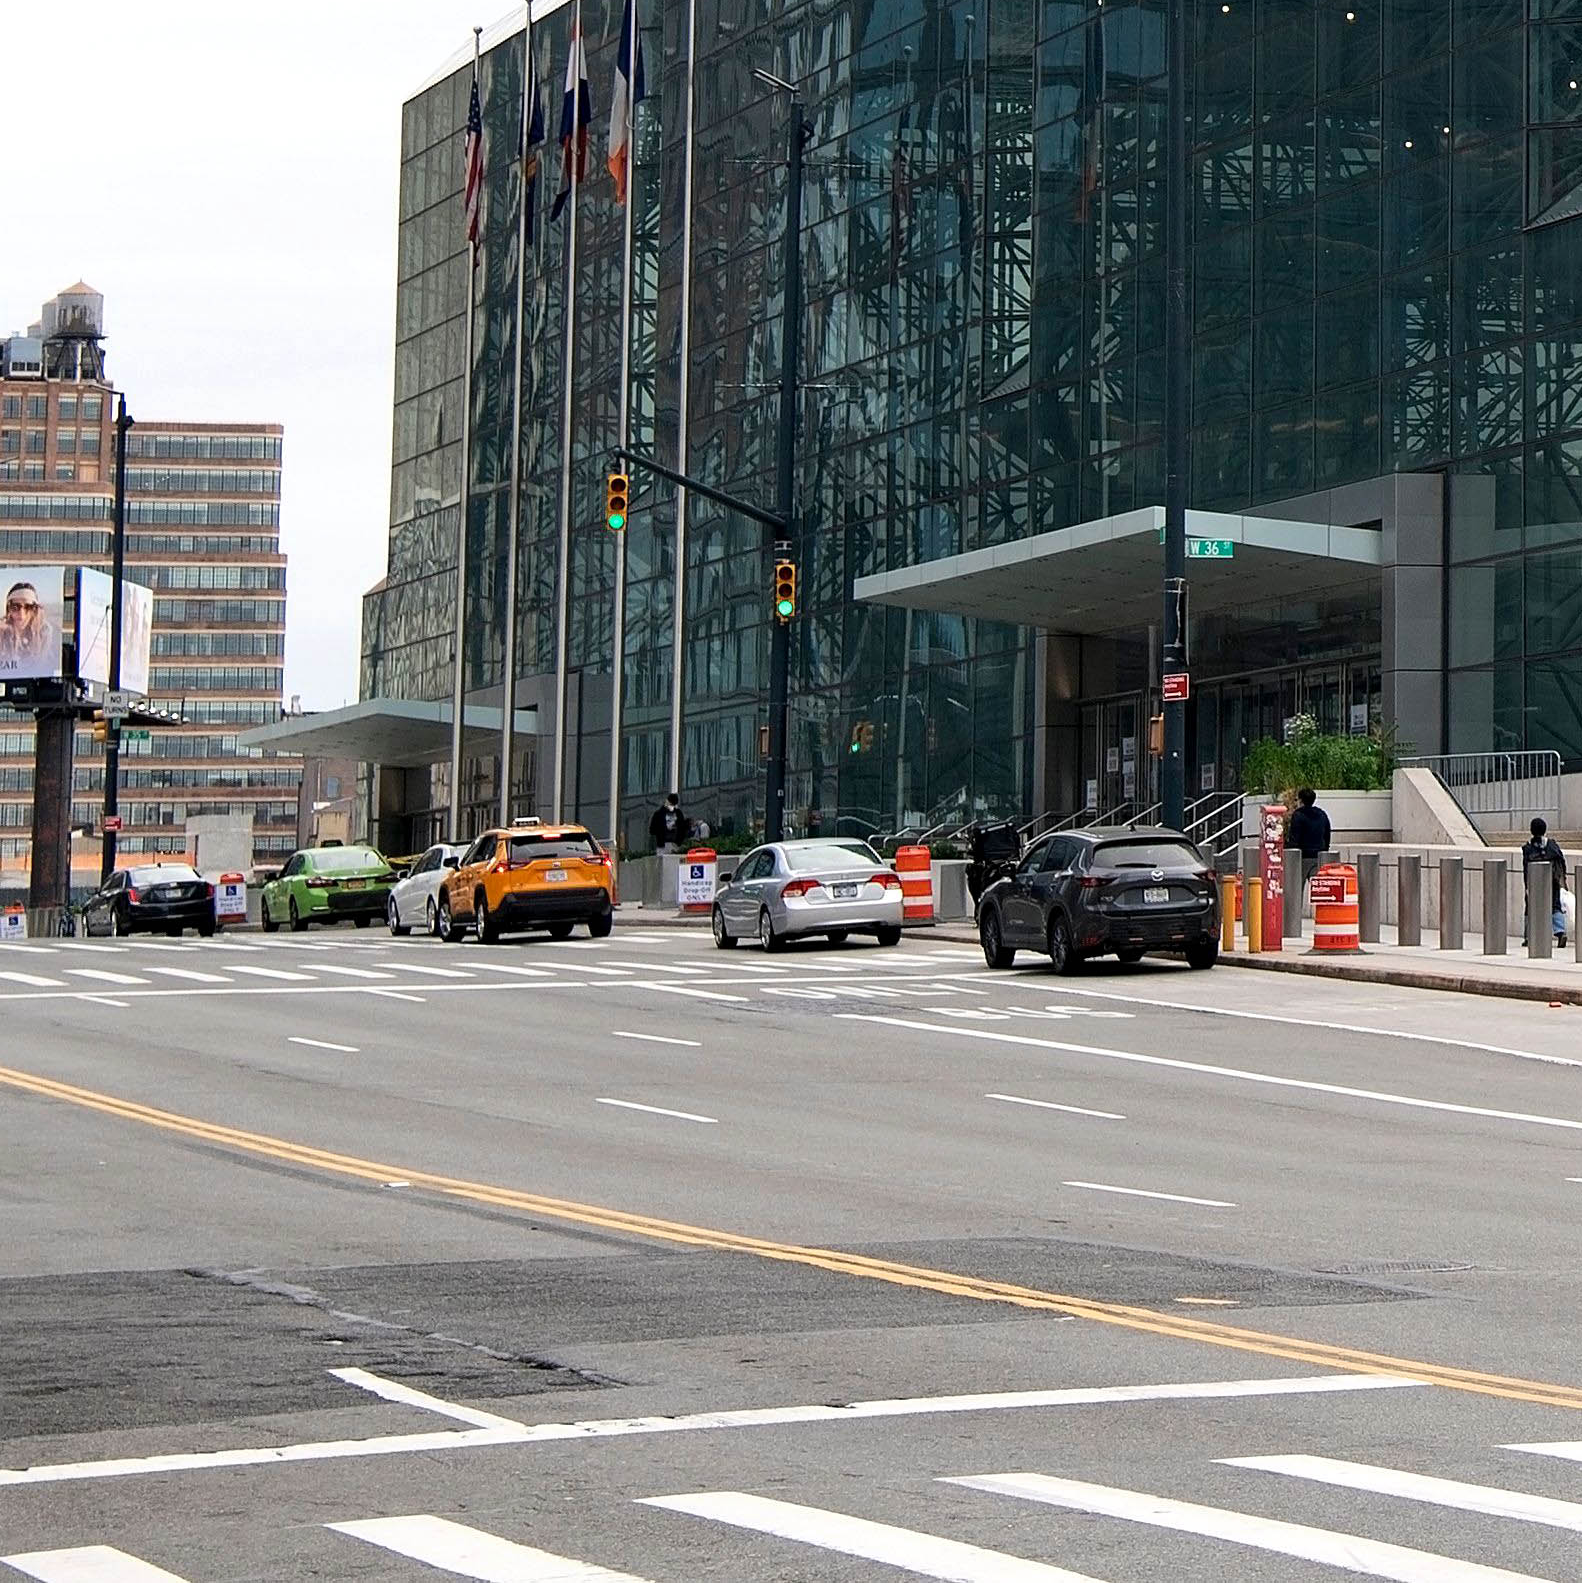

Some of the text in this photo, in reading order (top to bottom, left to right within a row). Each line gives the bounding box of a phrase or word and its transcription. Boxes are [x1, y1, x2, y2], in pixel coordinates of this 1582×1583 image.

[1190, 540, 1201, 555] W
[1204, 540, 1220, 556] 36
[110, 695, 122, 704] NO
[757, 983, 991, 1000] ONLY
[919, 1005, 1137, 1020] BUS
